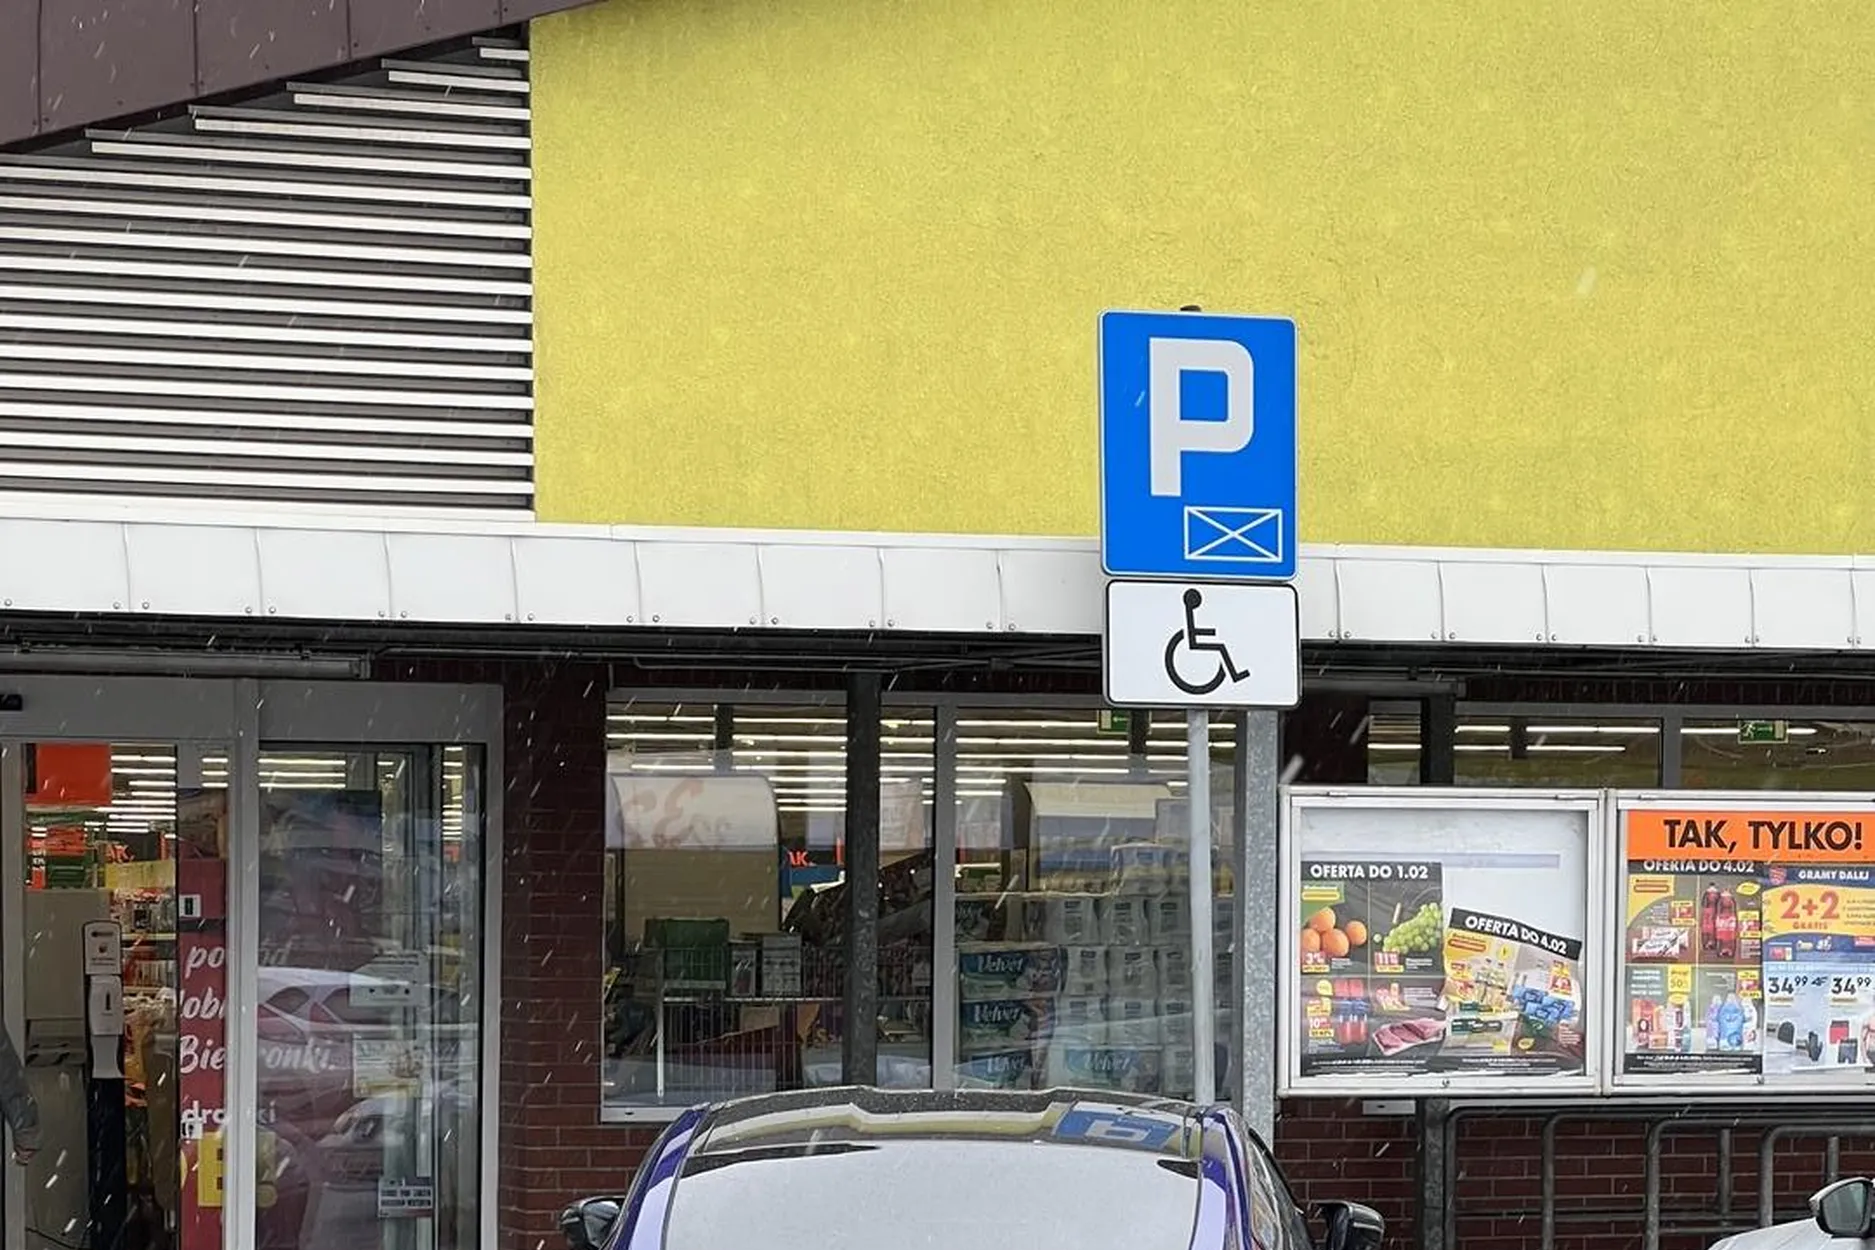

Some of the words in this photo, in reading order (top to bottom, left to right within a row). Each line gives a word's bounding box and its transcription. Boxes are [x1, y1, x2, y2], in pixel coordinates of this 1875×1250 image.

[1148, 337, 1255, 497] P
[1663, 819, 1737, 853] TAK,
[1748, 820, 1863, 850] TYLKO!
[1310, 864, 1365, 878] OFERTA
[1369, 865, 1392, 878] DO
[1397, 865, 1428, 879] 1.02
[1643, 860, 1696, 871] OFERTA
[1699, 860, 1721, 872] DO
[1723, 860, 1755, 873] 4.02
[1798, 870, 1837, 880] GRAMY
[1839, 871, 1869, 880] DALEJ
[1780, 889, 1840, 920] 2+2
[1465, 916, 1519, 939] OFERTA
[1521, 928, 1538, 943] DO
[1540, 932, 1567, 954] 4.02
